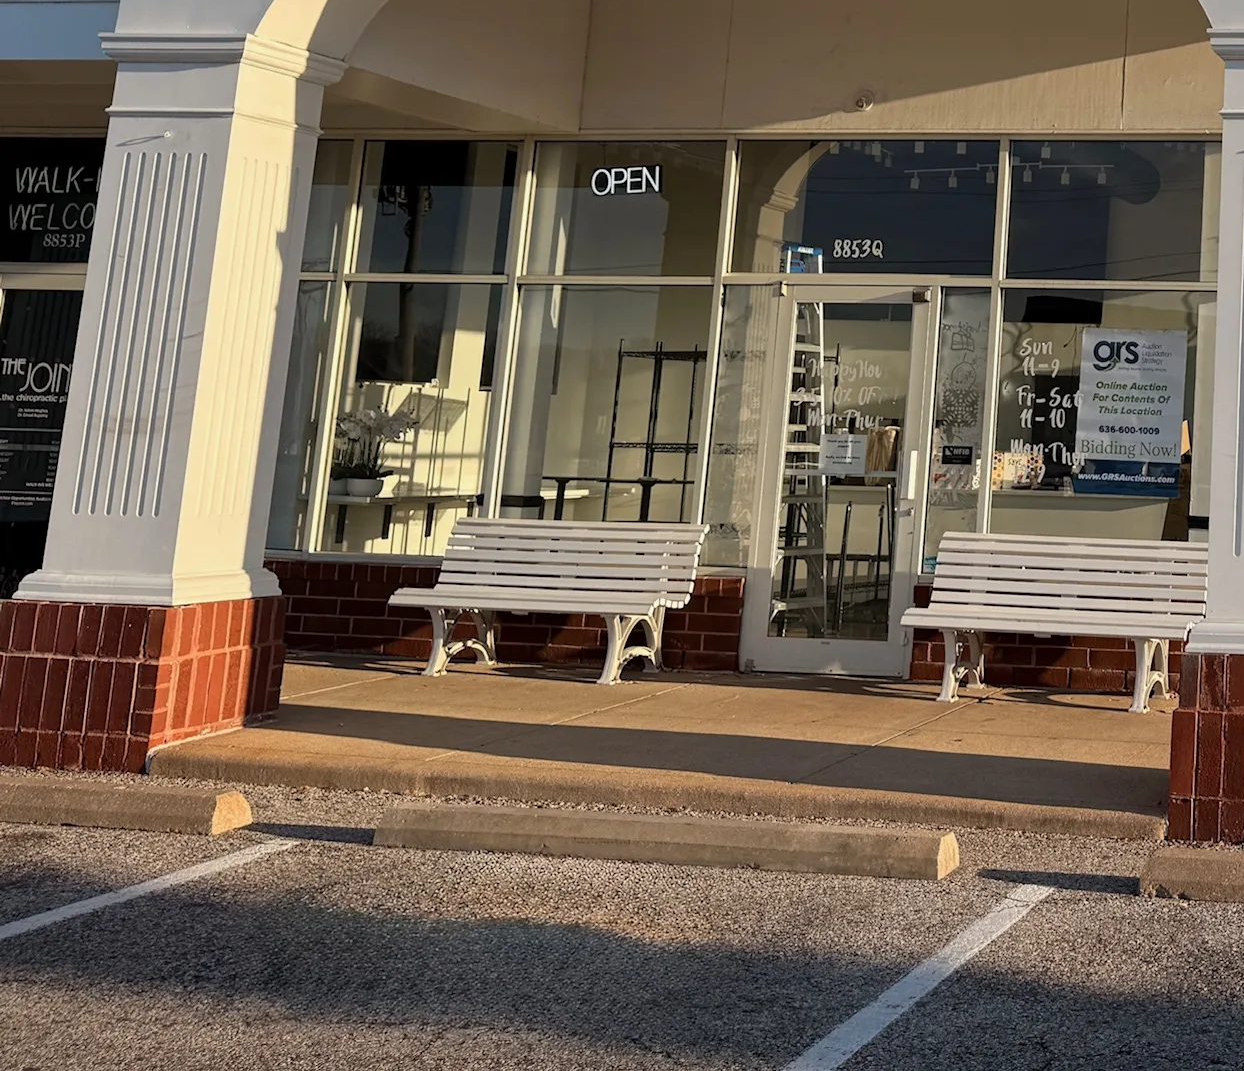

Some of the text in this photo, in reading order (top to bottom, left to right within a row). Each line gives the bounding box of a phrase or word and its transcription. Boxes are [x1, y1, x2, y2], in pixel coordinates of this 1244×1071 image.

[16, 166, 101, 193] WALK-I
[591, 165, 660, 196] OPEN
[9, 202, 95, 231] WELCO
[43, 233, 86, 248] 8853P
[833, 239, 883, 258] 8853Q
[1020, 337, 1052, 356] Sun
[1093, 340, 1139, 371] grs
[1, 358, 27, 375] THE
[808, 358, 856, 382] Hppy
[19, 362, 72, 393] JOIN
[1096, 381, 1168, 391] Online Auction
[16, 394, 58, 403] chiropractic
[1092, 393, 1171, 404] For Contents Of
[1099, 406, 1162, 416] This Location
[1099, 425, 1160, 435] 636-600-1009
[1080, 439, 1177, 459] Bidding Now!
[1078, 473, 1175, 484] www.GRSAuctions.com
